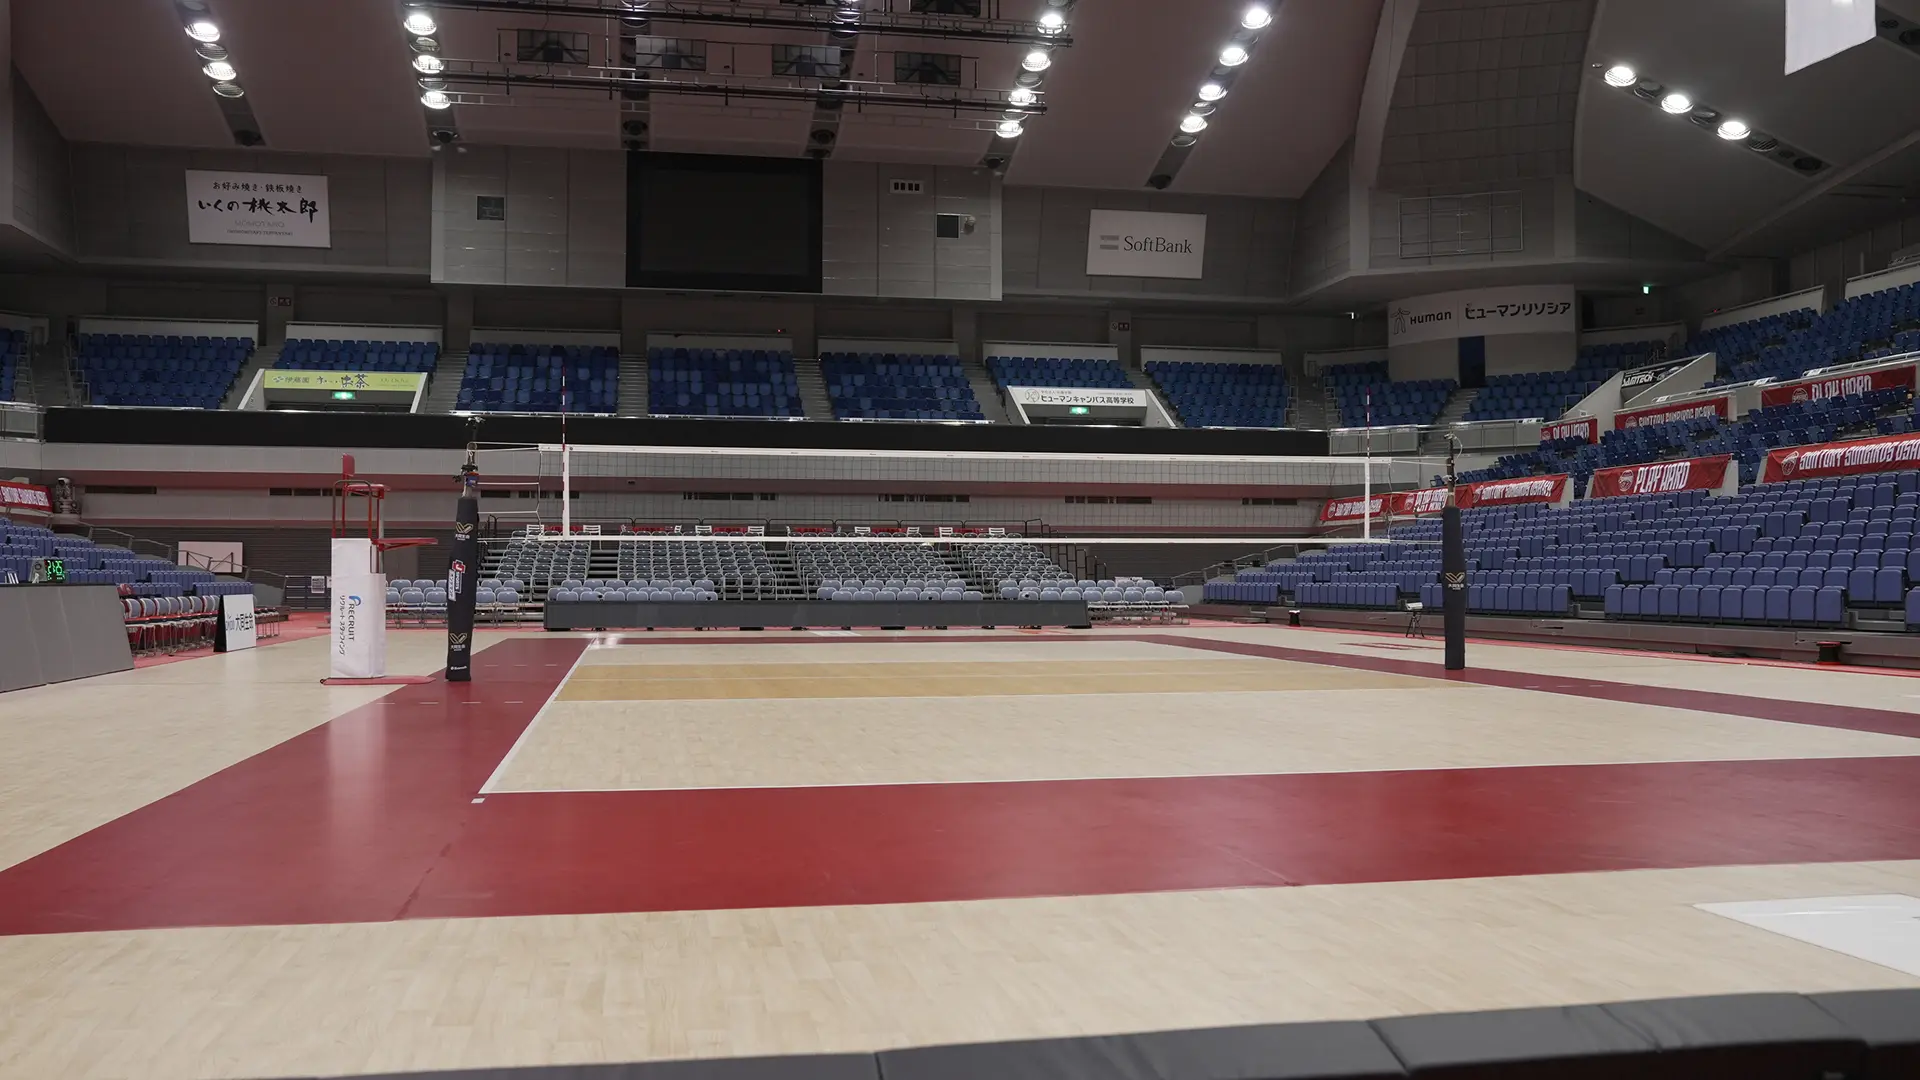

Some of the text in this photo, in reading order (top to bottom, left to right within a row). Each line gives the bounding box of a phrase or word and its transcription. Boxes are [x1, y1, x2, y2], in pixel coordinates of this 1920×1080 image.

[198, 197, 319, 223] いくの桃太郎
[1123, 235, 1193, 254] SoftBank
[1465, 302, 1572, 320] ヒューマンリソシア
[1040, 394, 1135, 405] ヒューマンキャンパス高等学校
[1634, 461, 1691, 493] PLAY HARD
